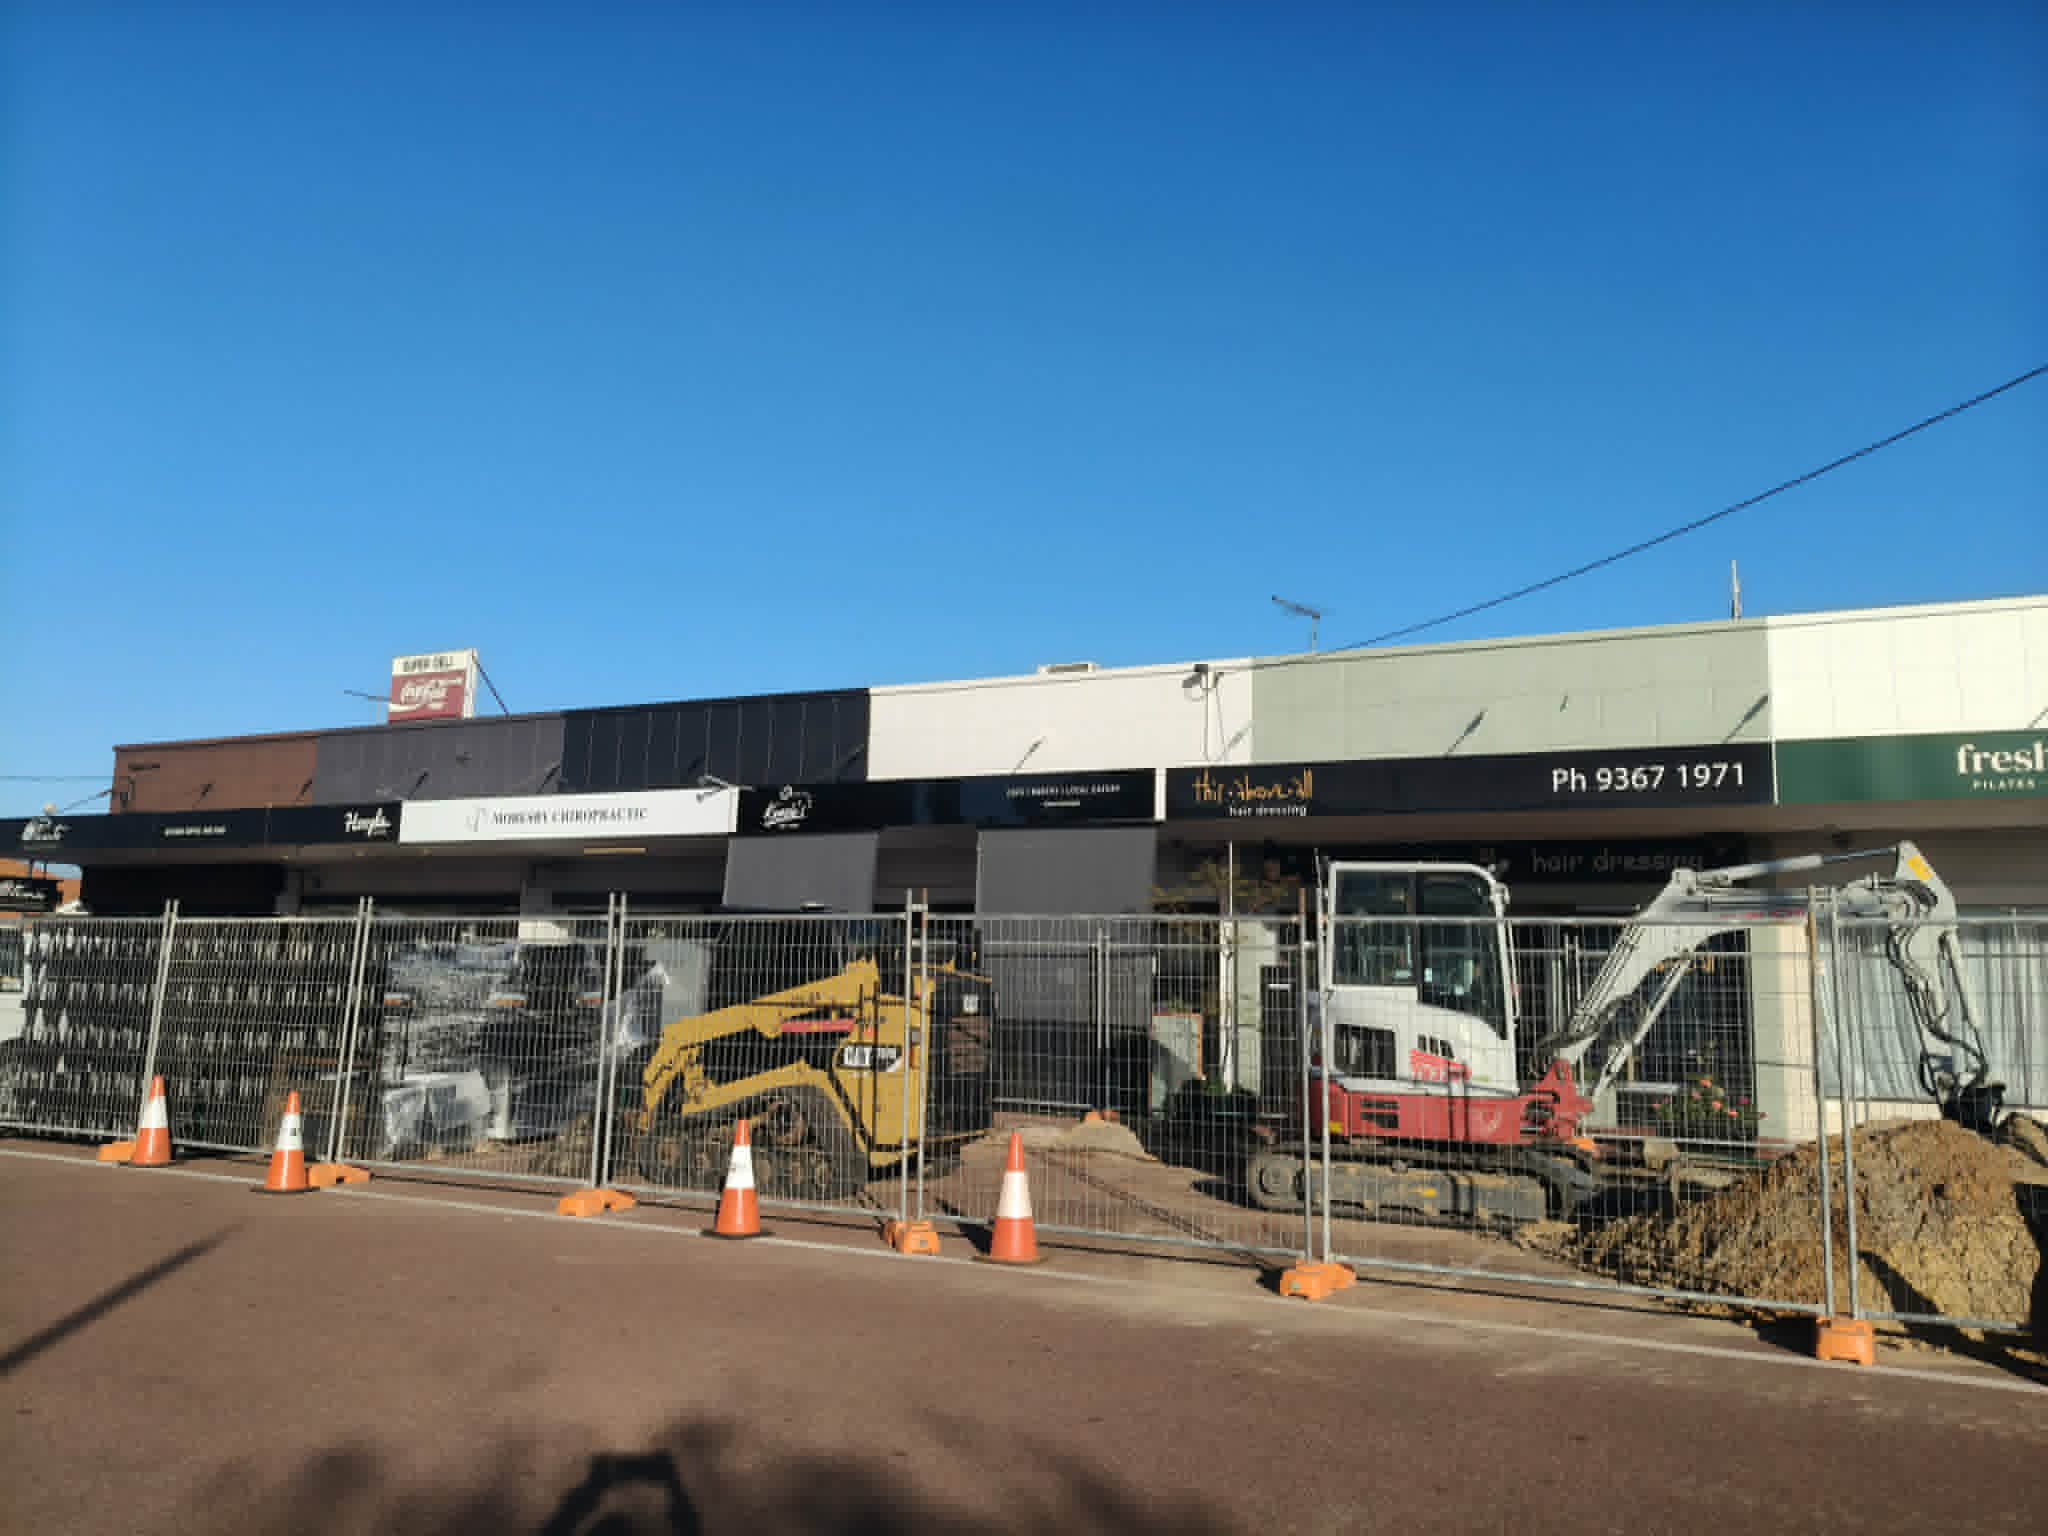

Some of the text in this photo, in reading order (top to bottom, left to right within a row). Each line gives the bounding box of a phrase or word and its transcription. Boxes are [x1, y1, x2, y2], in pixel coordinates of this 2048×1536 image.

[1552, 763, 1744, 792] Ph 9367 1971
[1531, 848, 1584, 873] hair
